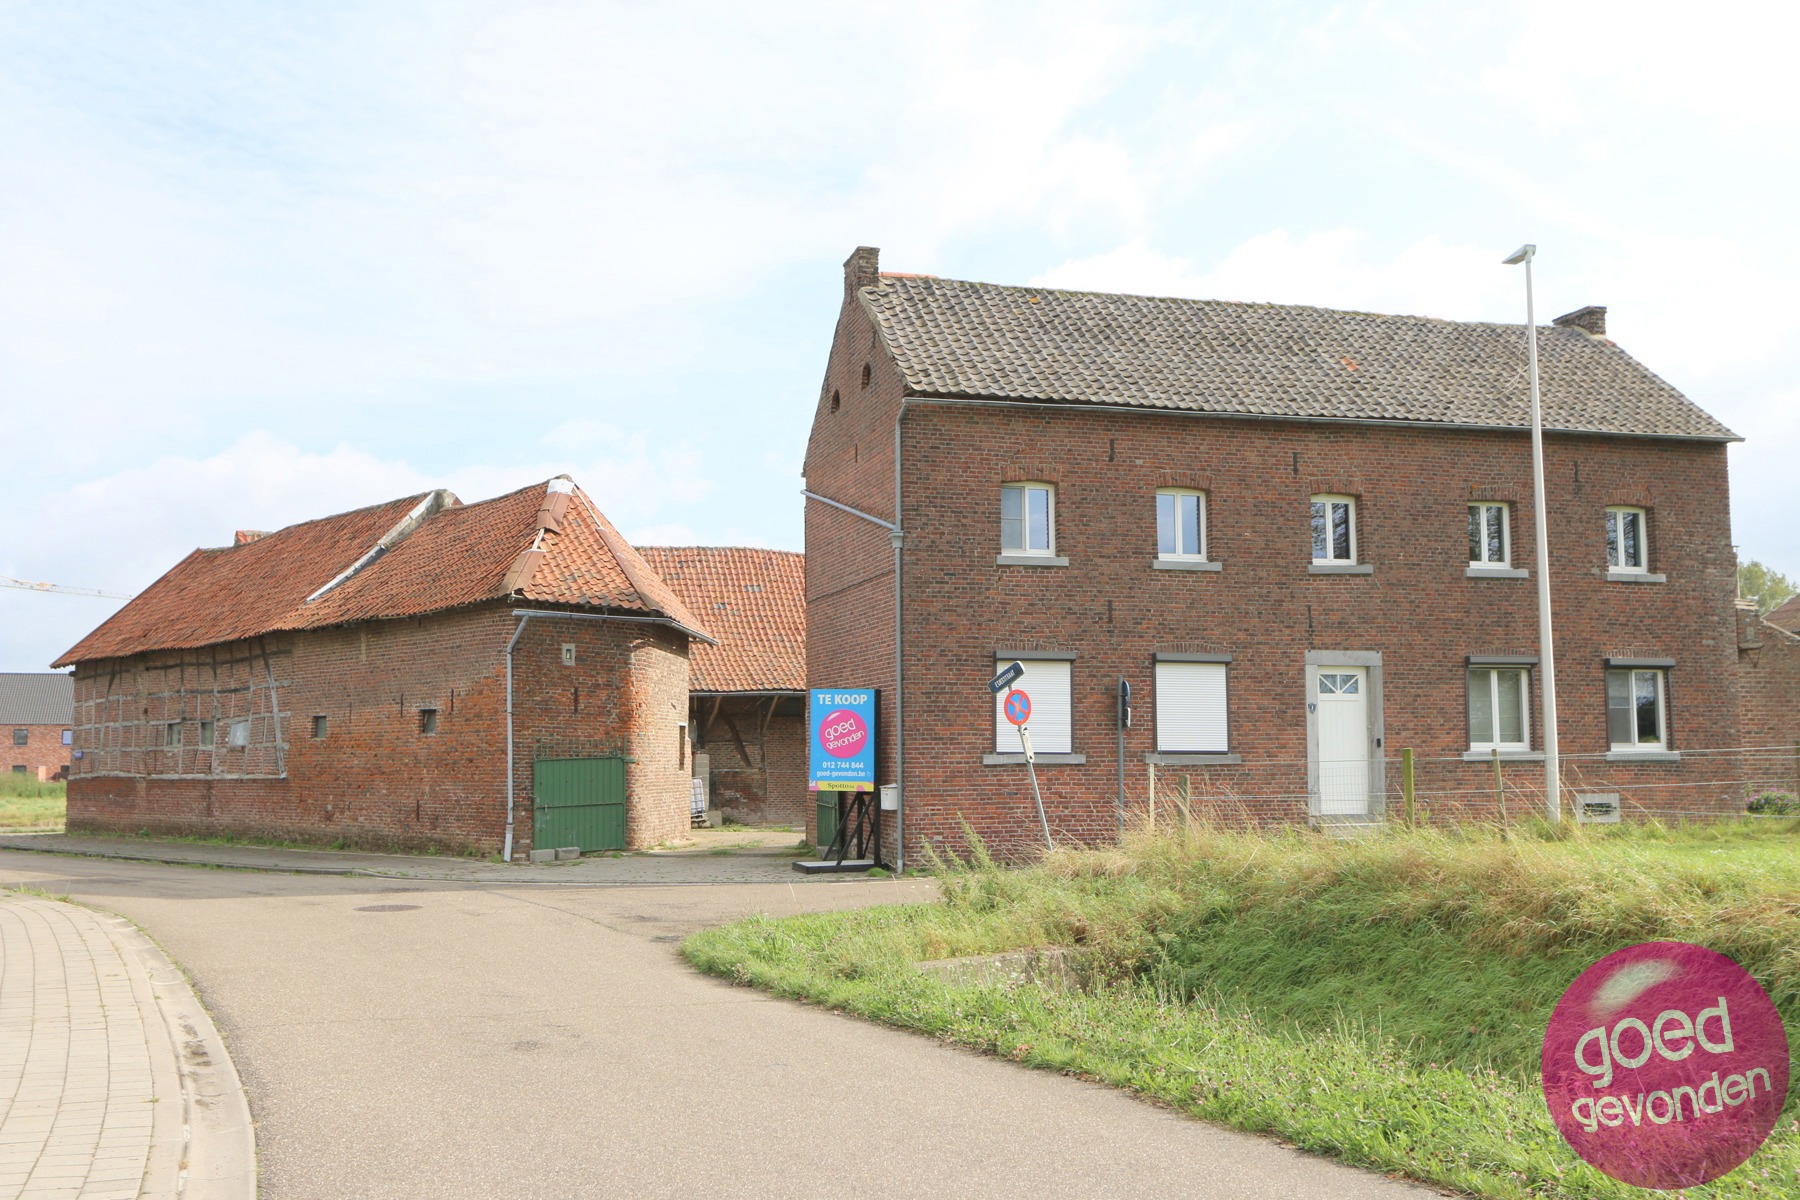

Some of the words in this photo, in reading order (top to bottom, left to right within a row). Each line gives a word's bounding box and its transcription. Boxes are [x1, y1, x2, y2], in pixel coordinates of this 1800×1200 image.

[817, 694, 832, 705] TE
[834, 694, 868, 705] KOOP
[825, 717, 856, 741] goed
[826, 730, 865, 750] gevonden
[822, 761, 836, 769] 012
[837, 761, 850, 769] 744
[851, 761, 864, 769] 844
[816, 769, 866, 778] goed-gevonden.be
